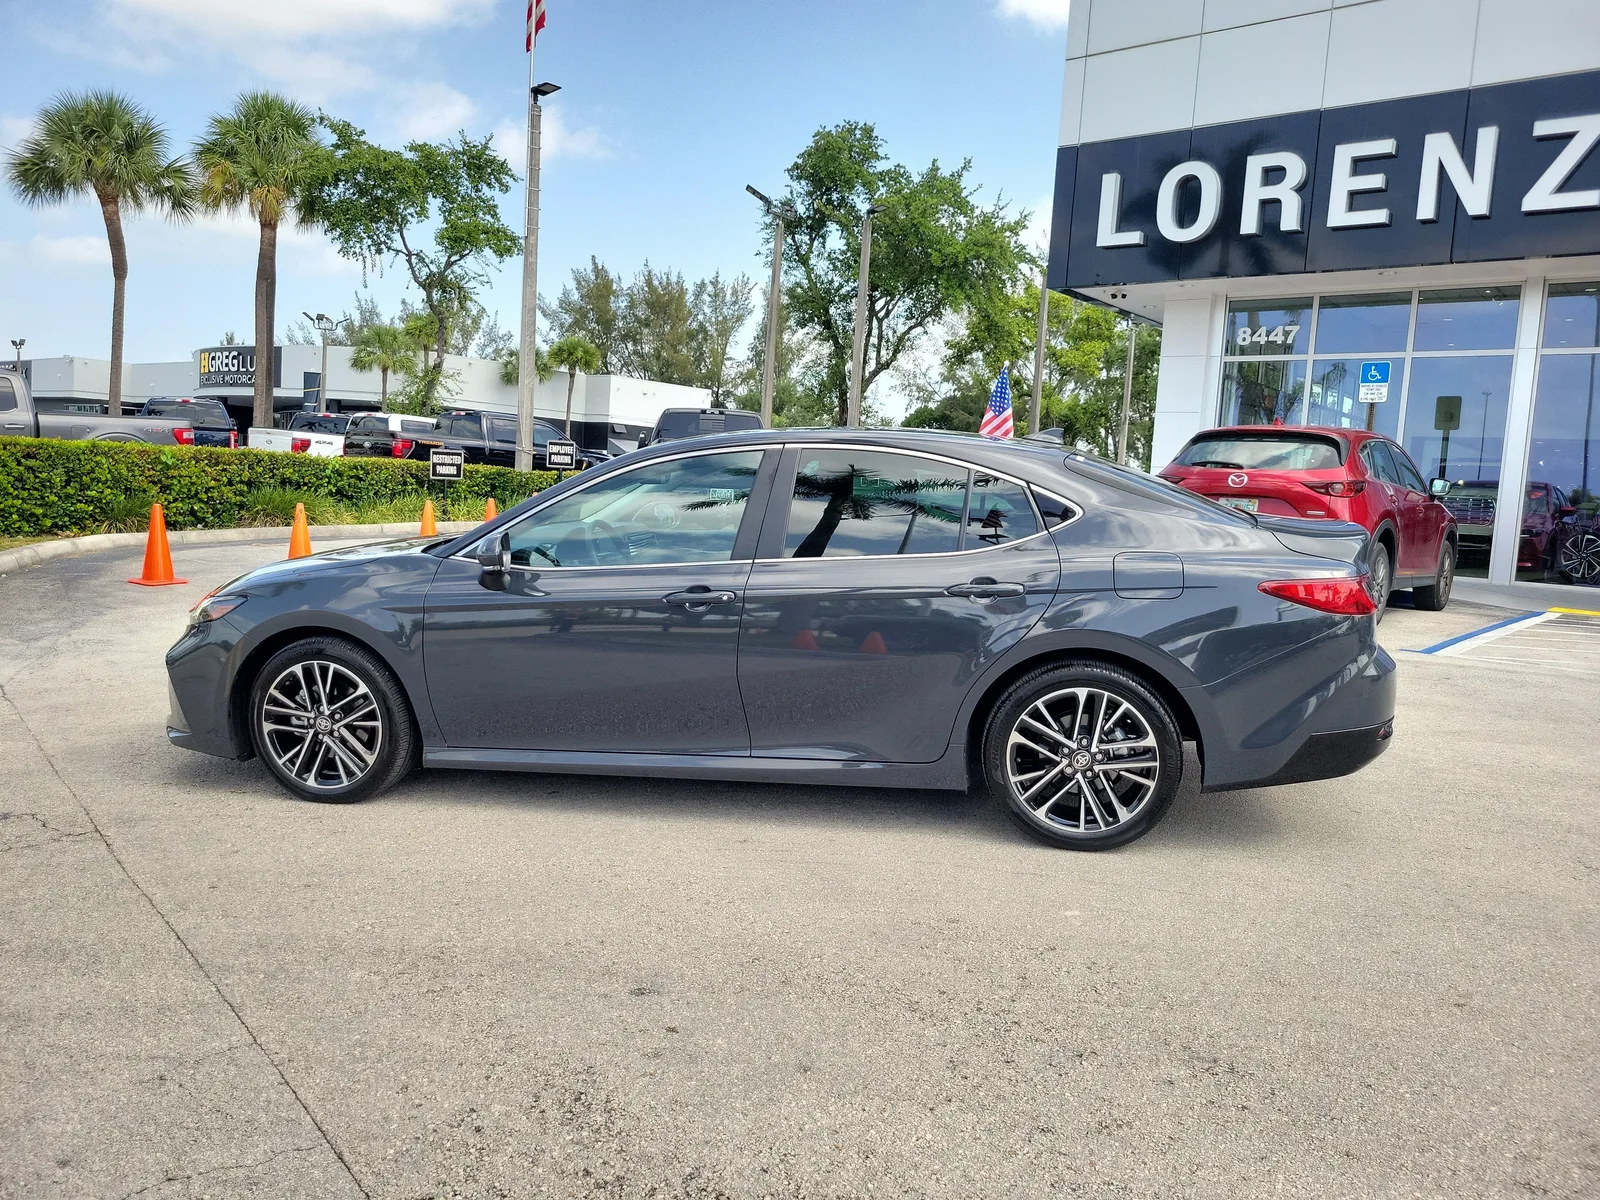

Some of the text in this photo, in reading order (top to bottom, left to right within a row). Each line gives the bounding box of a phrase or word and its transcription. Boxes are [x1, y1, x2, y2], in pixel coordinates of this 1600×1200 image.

[1096, 113, 1600, 249] LORENZ
[1236, 325, 1301, 346] 8447
[200, 374, 255, 385] EXCLUSIVE MOTORCA
[549, 444, 574, 454] EMPLOYEE
[432, 454, 462, 464] RESTRICTED
[550, 454, 572, 464] PARKING
[436, 465, 457, 475] PARKING
